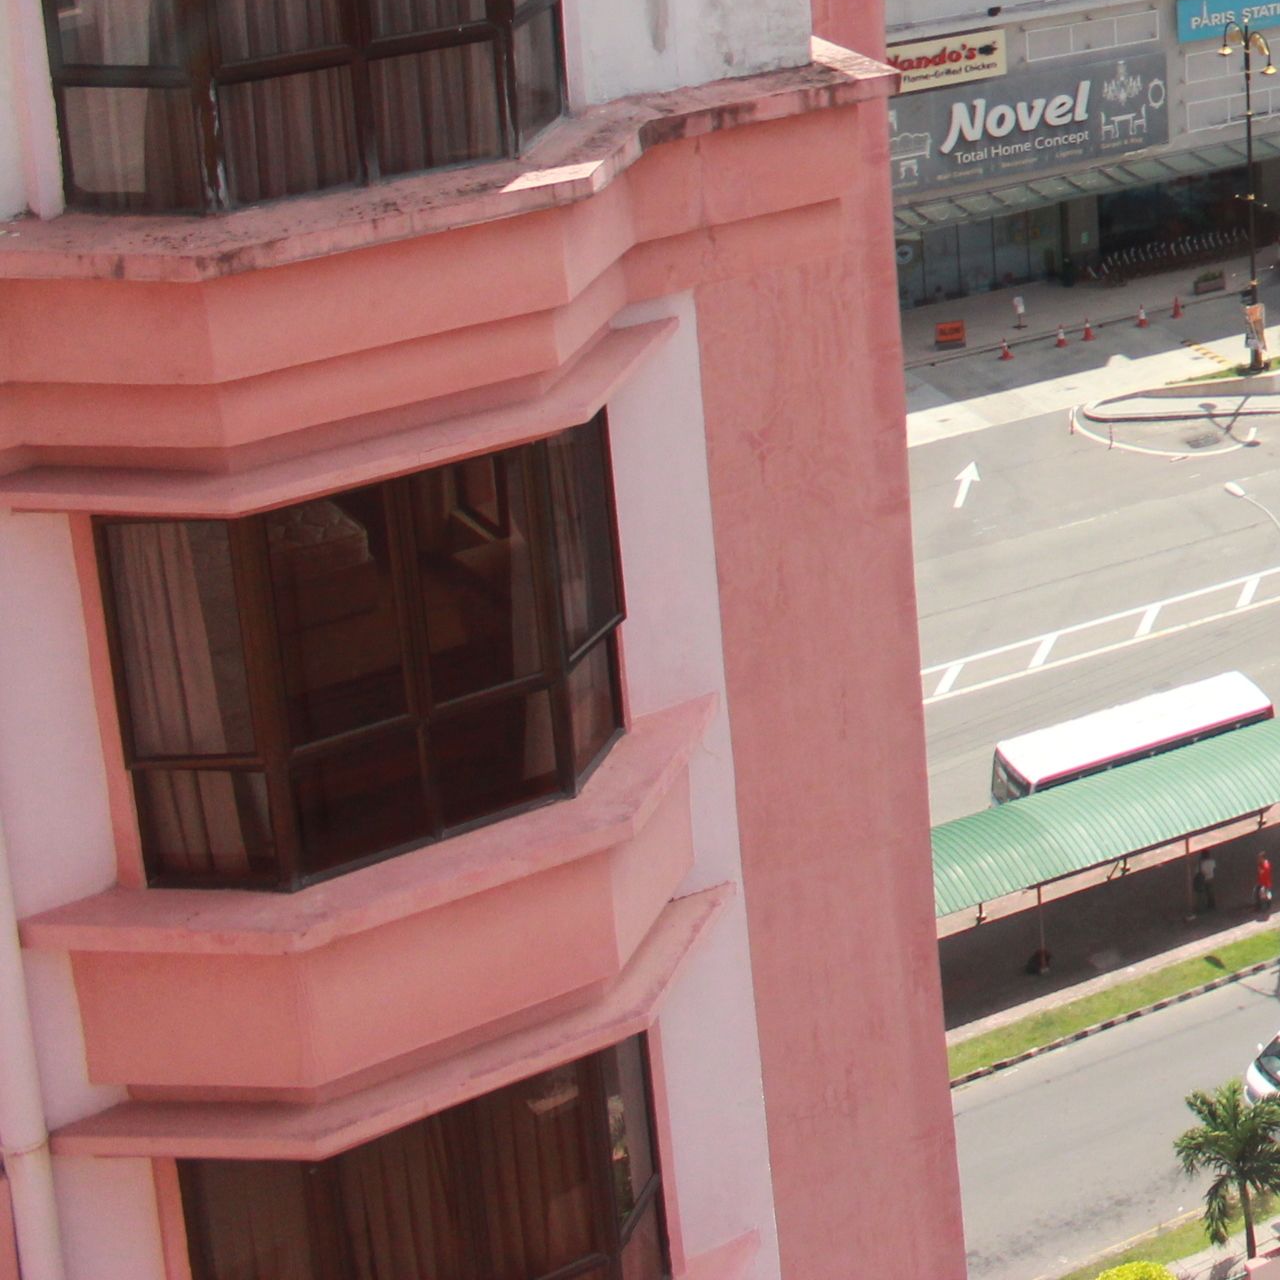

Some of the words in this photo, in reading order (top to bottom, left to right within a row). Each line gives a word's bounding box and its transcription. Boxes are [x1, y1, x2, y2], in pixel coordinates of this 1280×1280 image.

[1191, 0, 1235, 29] PARIS
[964, 61, 998, 73] Chicken
[939, 80, 1091, 154] Novel
[955, 148, 988, 164] Total
[991, 141, 1032, 158] Home
[1035, 130, 1089, 151] Concept
